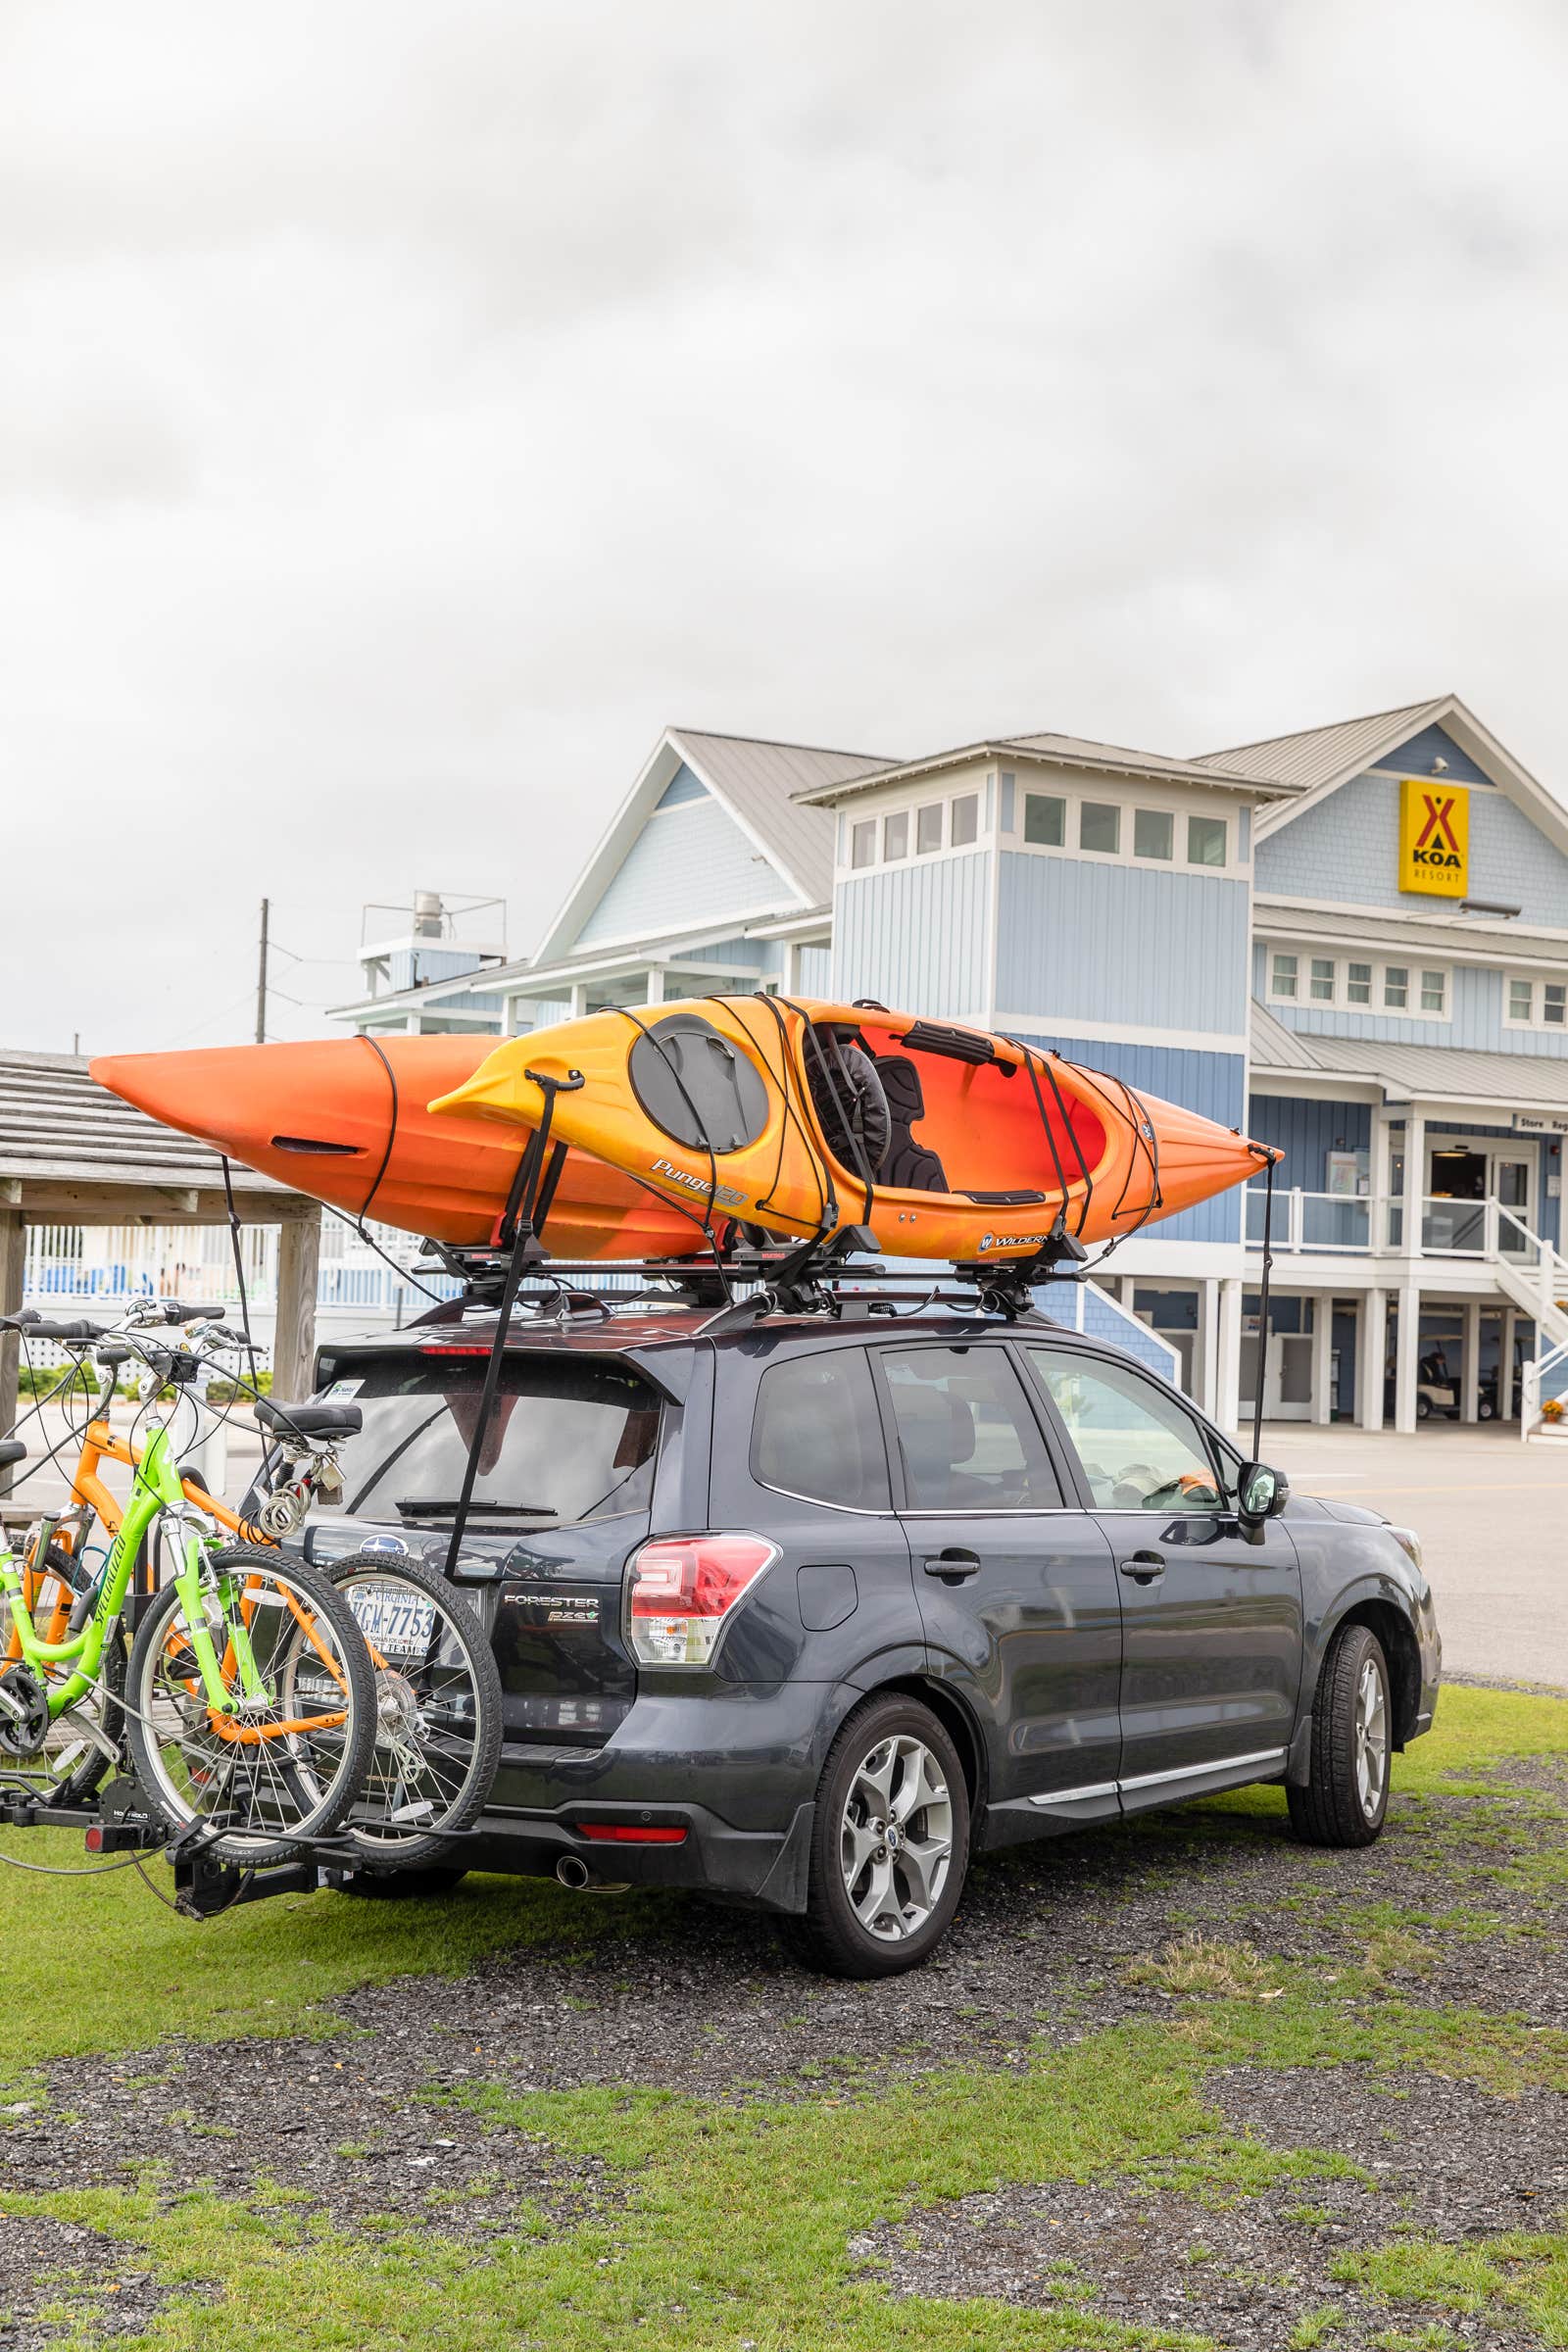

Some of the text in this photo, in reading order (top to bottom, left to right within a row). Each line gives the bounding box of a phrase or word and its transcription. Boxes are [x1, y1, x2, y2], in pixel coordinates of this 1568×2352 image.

[1413, 850, 1461, 868] KOA
[1414, 868, 1459, 883] RESORT
[1521, 1118, 1544, 1128] Store
[651, 1158, 712, 1192] Pungo
[996, 1232, 1072, 1247] WILDERN
[95, 1535, 126, 1629] SPECIALIZED
[504, 1594, 600, 1608] FORESTER
